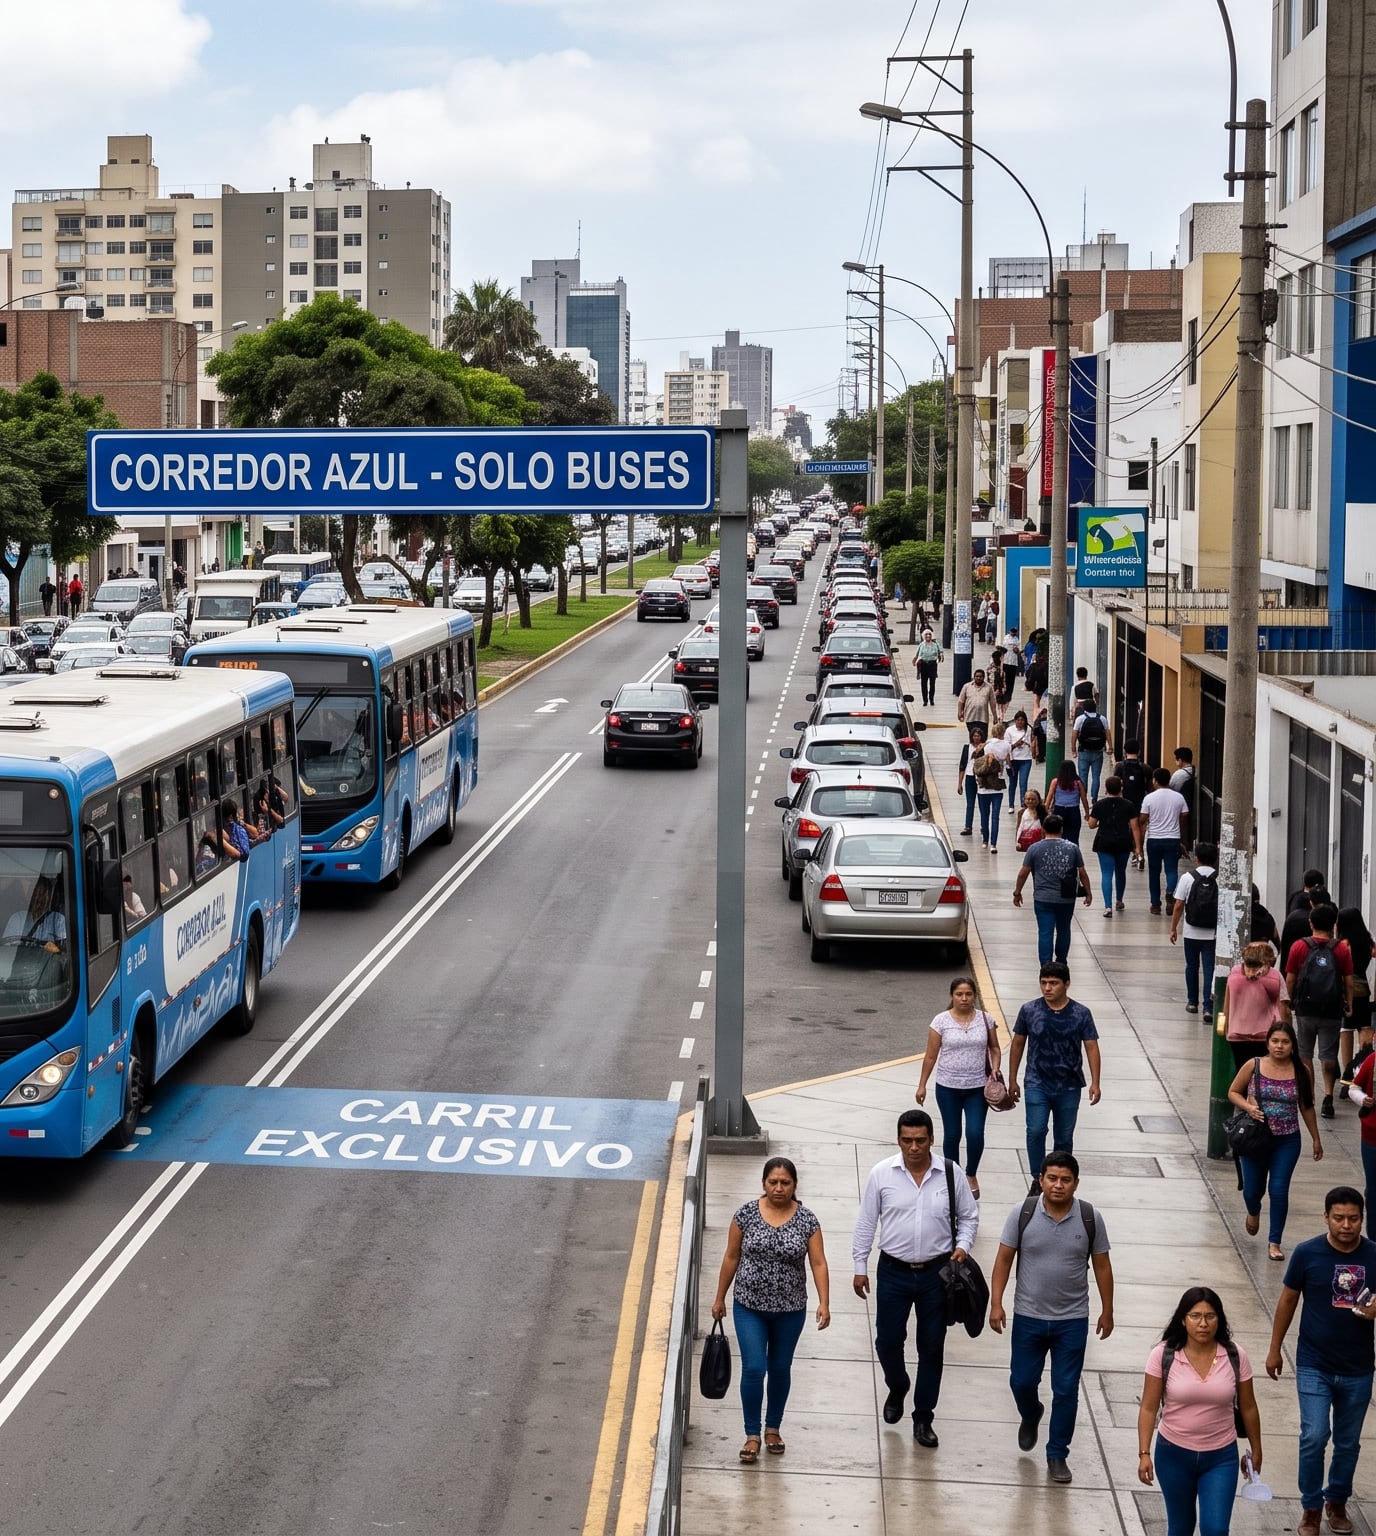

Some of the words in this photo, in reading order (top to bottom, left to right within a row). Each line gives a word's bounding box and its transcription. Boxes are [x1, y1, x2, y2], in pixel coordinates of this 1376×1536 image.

[110, 452, 313, 492] CORREDOR
[322, 452, 418, 491] AZUL
[430, 471, 443, 480] -
[454, 451, 554, 491] SOLO
[567, 450, 690, 490] BUSES
[339, 1099, 572, 1131] CARRIL
[245, 1129, 633, 1170] EXCLUSIVO
